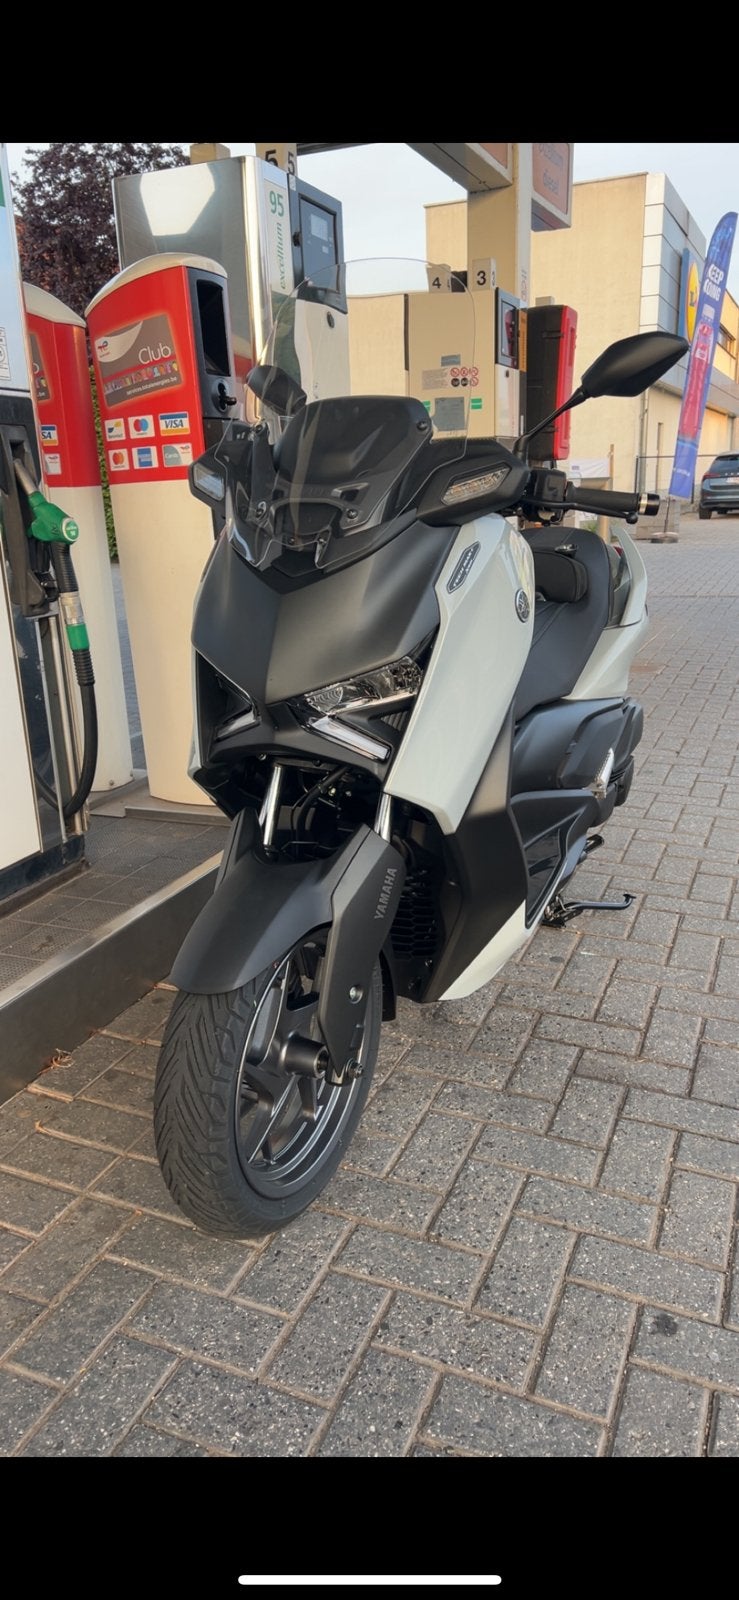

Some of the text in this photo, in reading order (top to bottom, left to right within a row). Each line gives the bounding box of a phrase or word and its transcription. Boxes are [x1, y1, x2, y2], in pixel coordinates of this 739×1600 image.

[287, 151, 296, 176] 5
[269, 190, 285, 217] 95
[431, 277, 442, 289] 4
[476, 270, 487, 286] 3
[138, 342, 172, 365] Club
[164, 419, 184, 429] VISA
[41, 431, 52, 440] SA
[374, 867, 398, 919] YAMAHA
